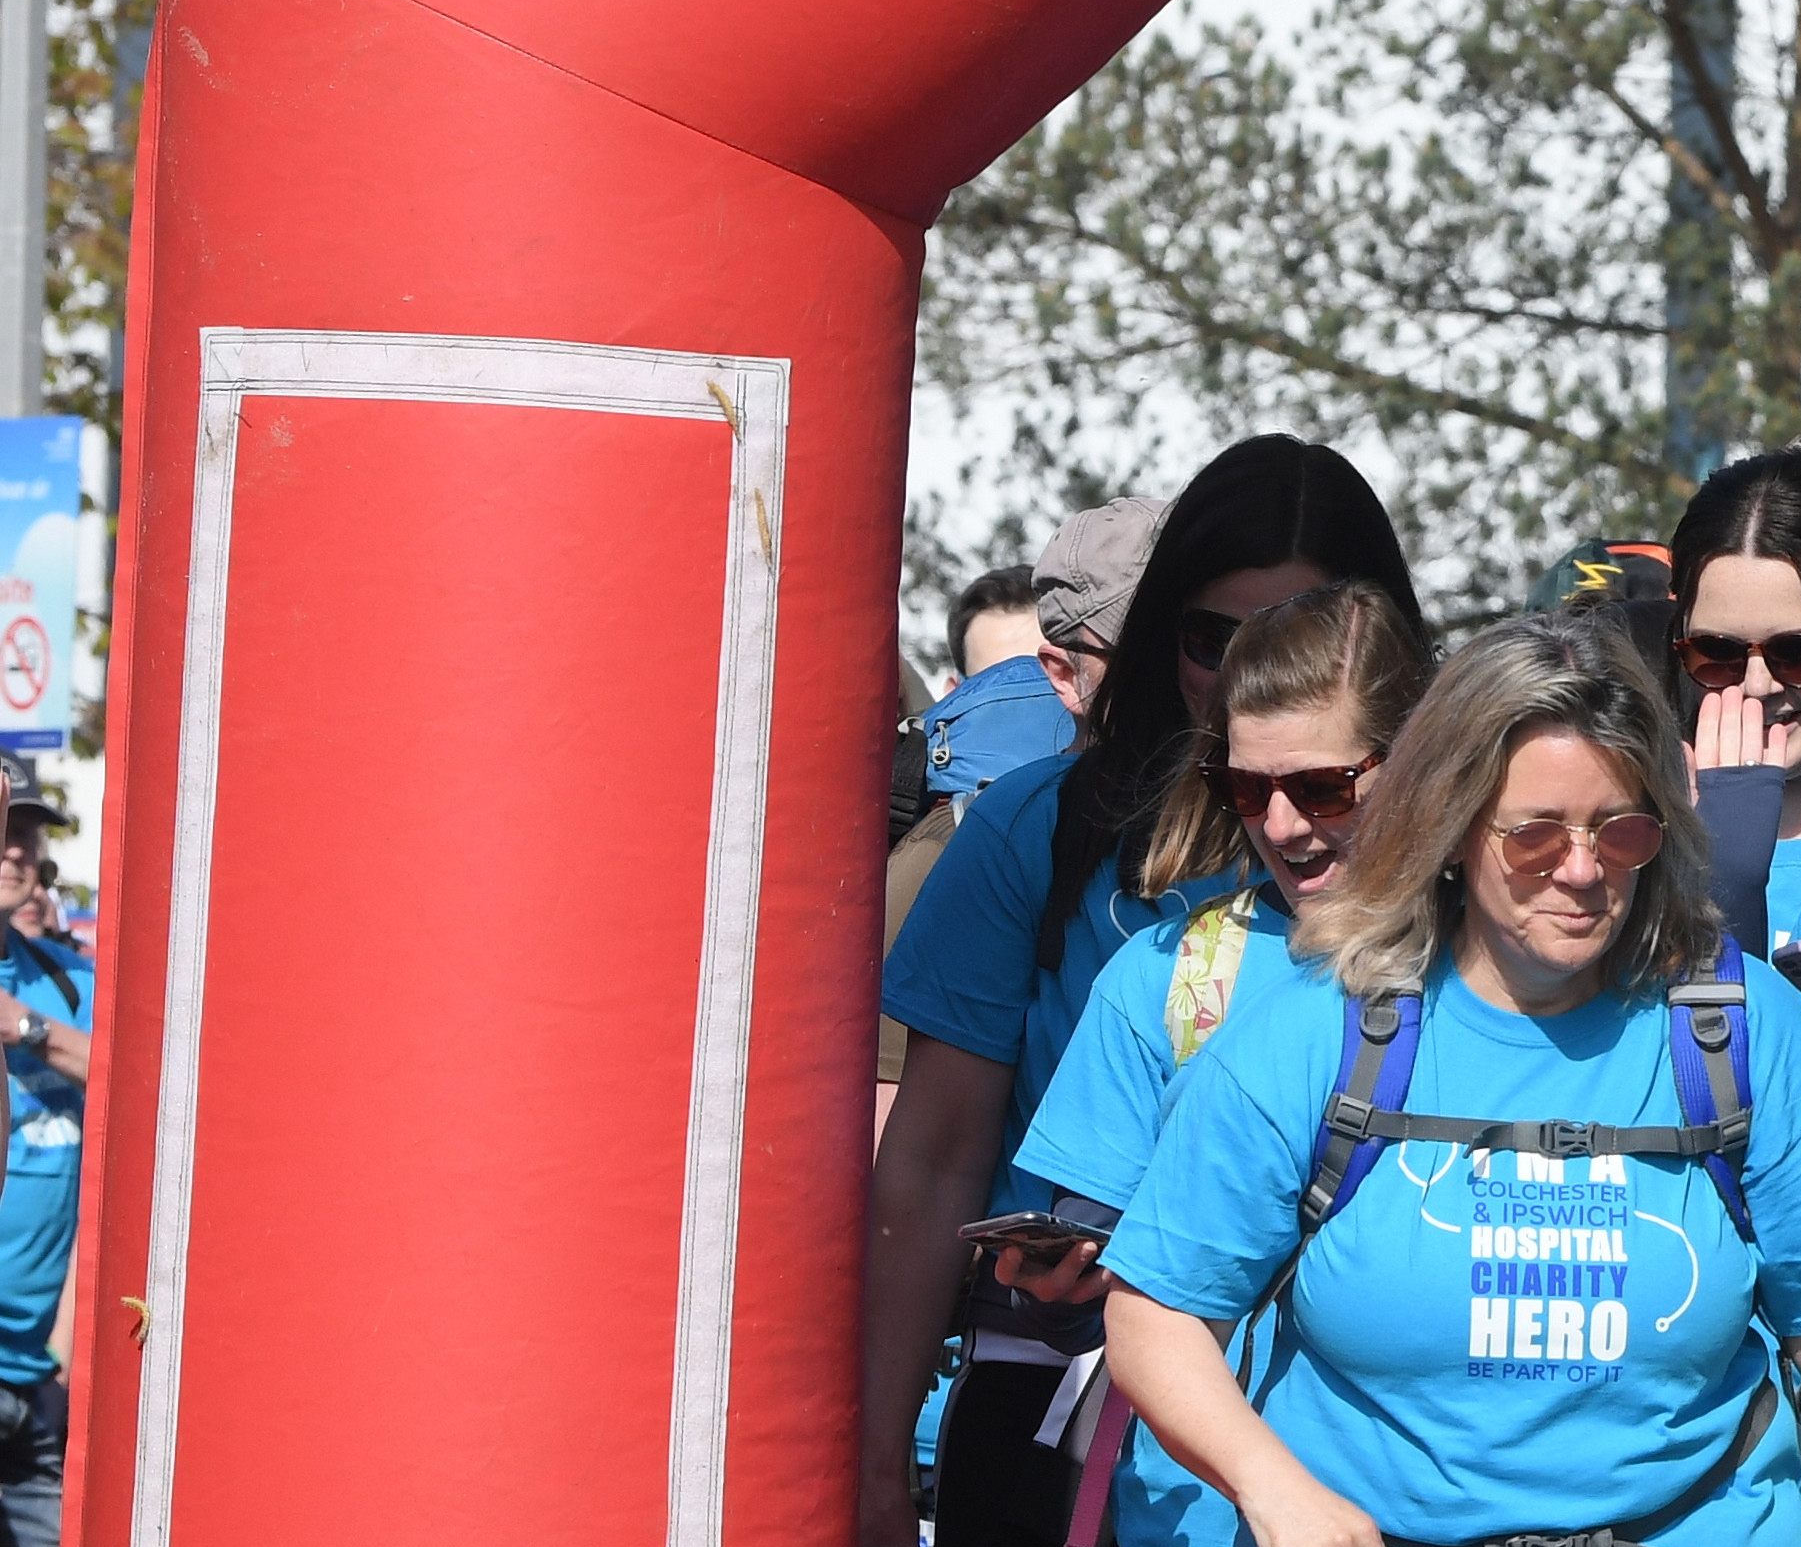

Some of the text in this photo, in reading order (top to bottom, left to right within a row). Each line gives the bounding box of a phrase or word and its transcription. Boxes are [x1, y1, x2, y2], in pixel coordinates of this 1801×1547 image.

[1589, 1154, 1628, 1185] A
[1470, 1180, 1628, 1202] COLCHESTER
[1473, 1202, 1628, 1227] & IPSWICH
[1471, 1226, 1628, 1262] HOSPITAL
[1470, 1261, 1629, 1298] CHARITY
[1469, 1297, 1628, 1362] HERO
[1467, 1361, 1623, 1383] BE PART OF IT
